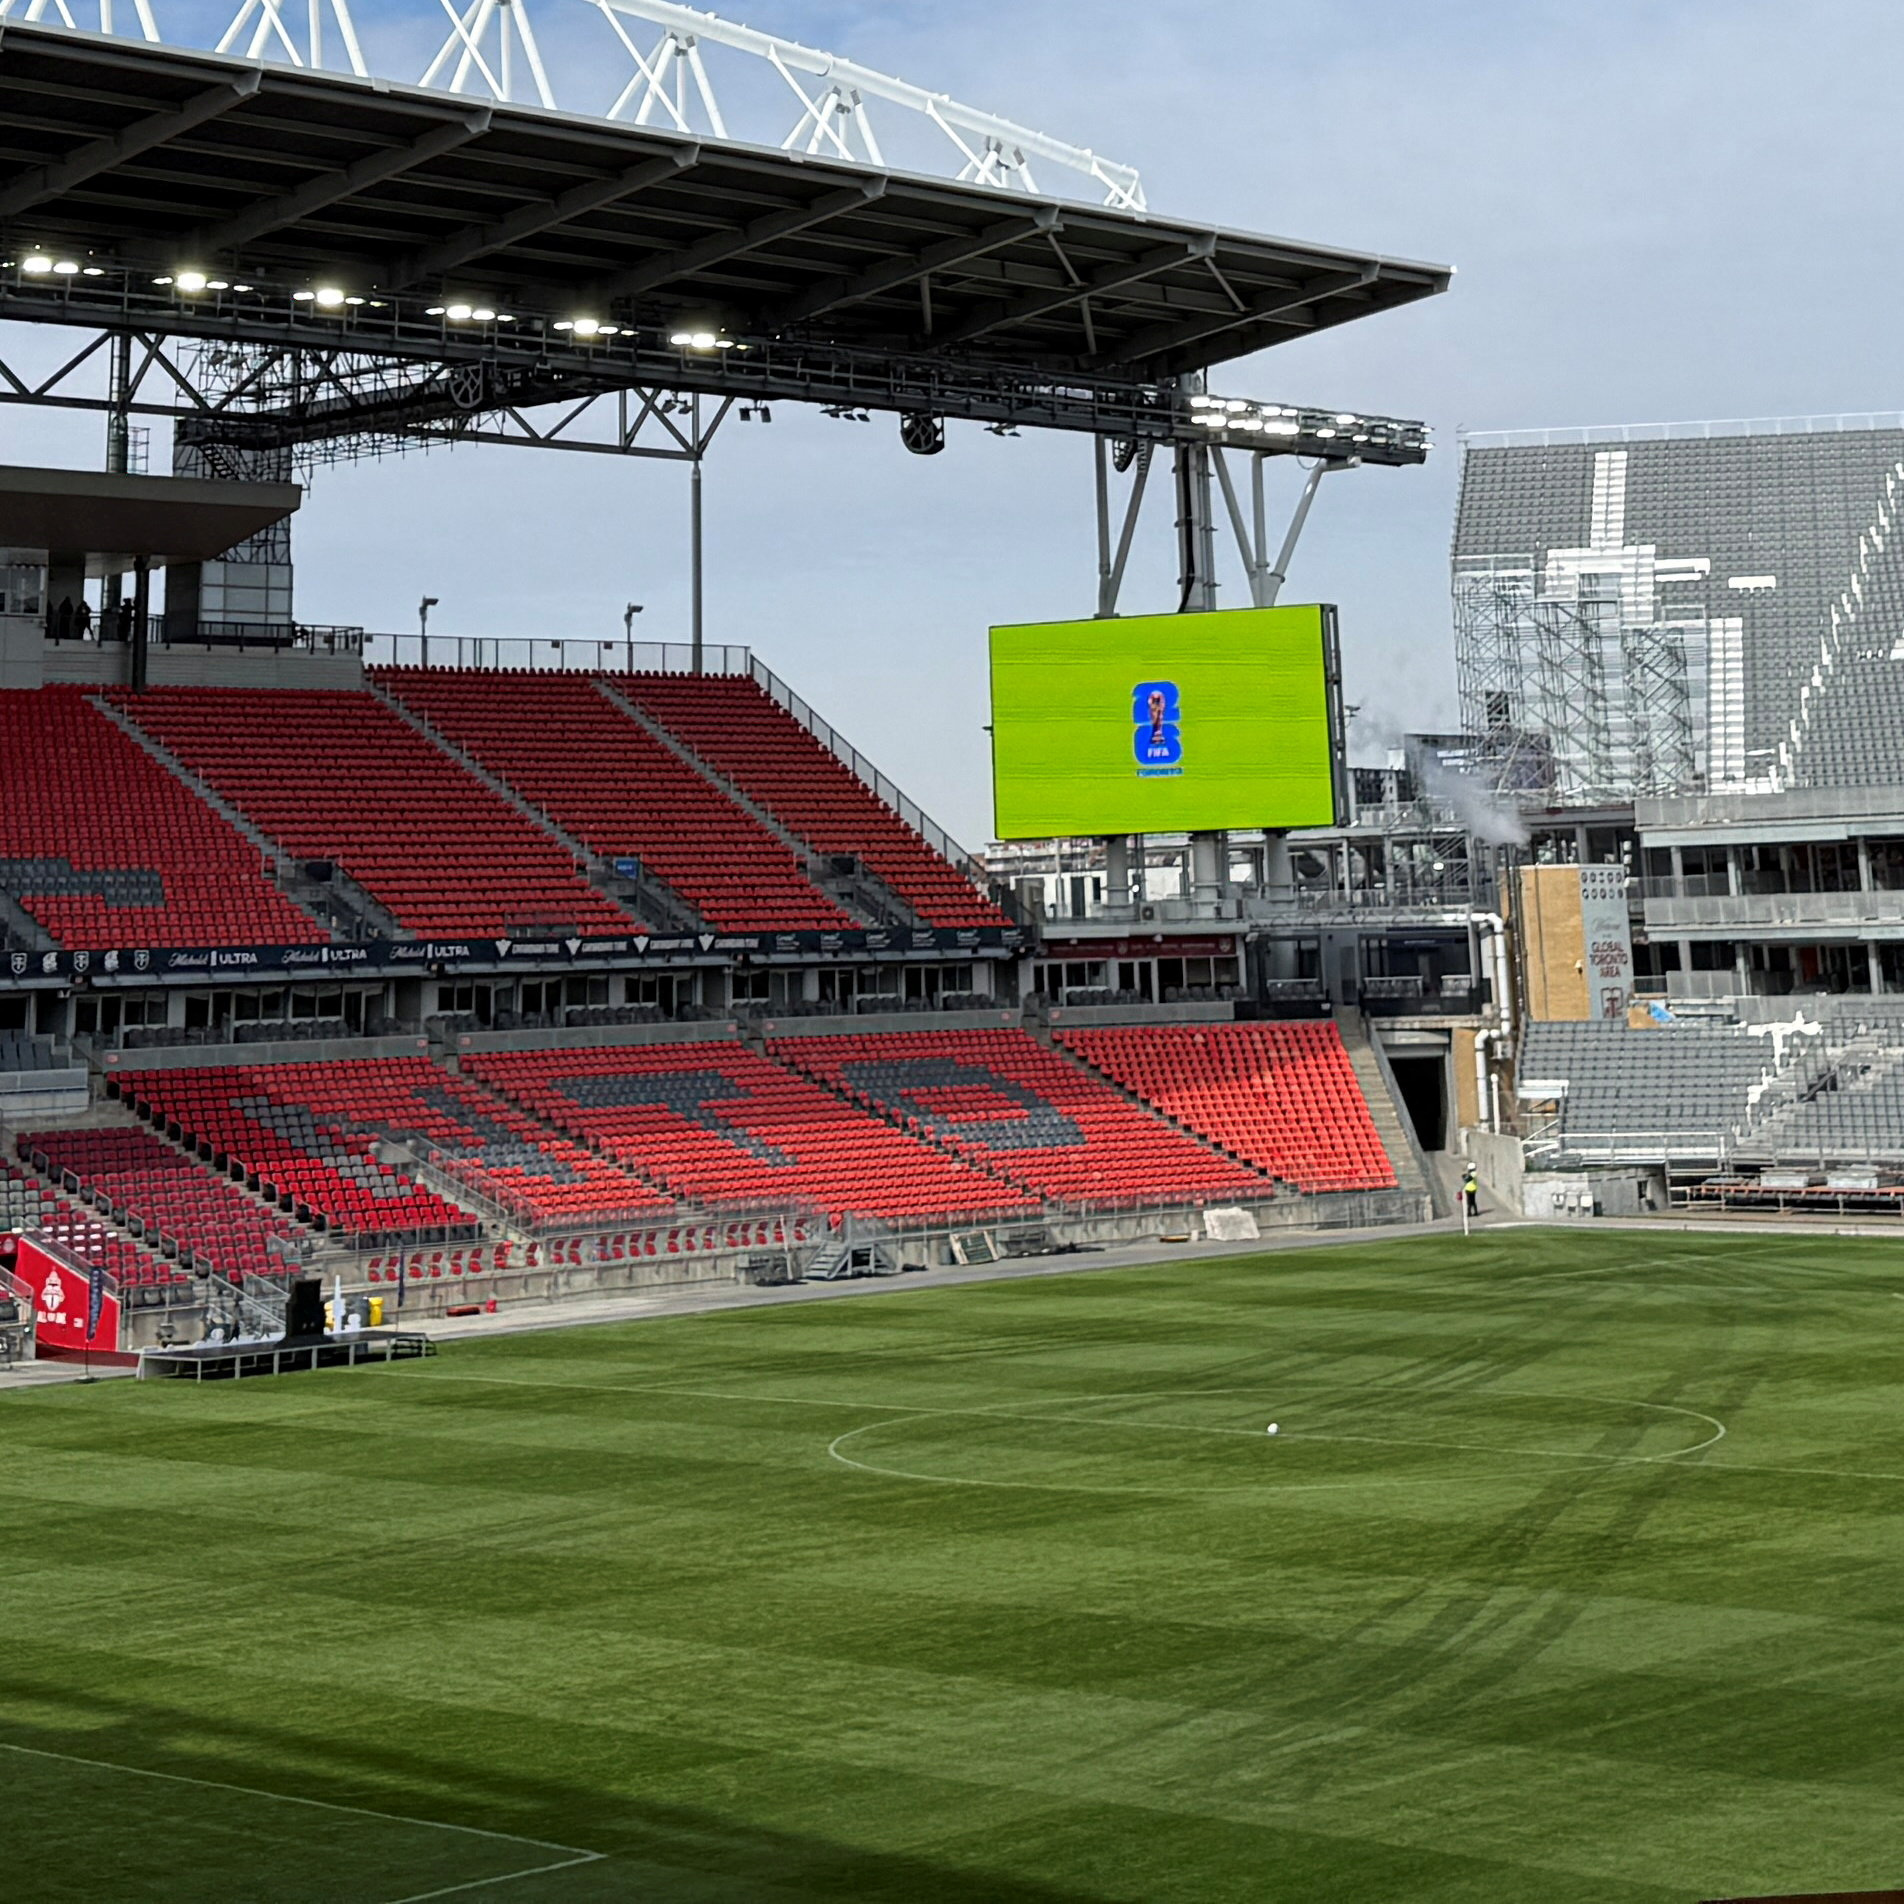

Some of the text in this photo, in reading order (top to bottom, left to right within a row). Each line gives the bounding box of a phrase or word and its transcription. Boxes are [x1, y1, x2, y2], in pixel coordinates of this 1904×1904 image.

[331, 949, 367, 960] ULTRA
[435, 946, 469, 957] ULTRA
[219, 953, 257, 964] ULTRA
[1589, 954, 1628, 966] TORONTO
[1600, 967, 1621, 978] AREA
